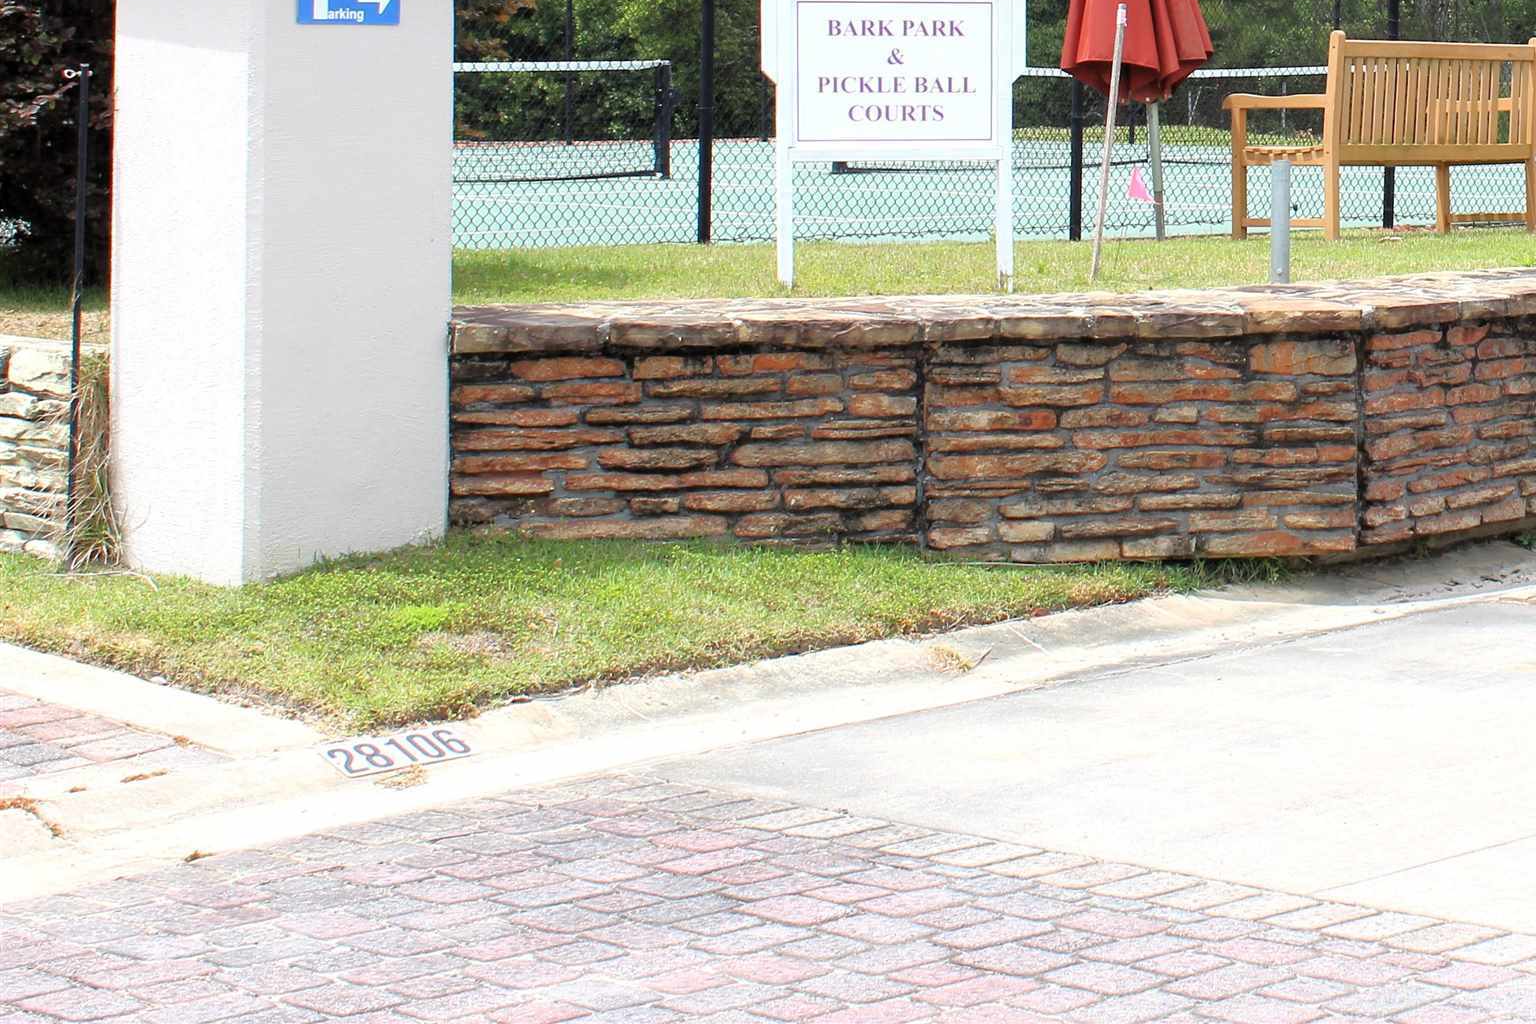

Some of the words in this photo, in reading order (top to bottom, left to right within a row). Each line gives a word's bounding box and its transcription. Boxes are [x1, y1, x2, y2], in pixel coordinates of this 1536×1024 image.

[827, 19, 894, 37] BARK
[902, 19, 966, 37] PARK
[887, 47, 904, 65] &
[818, 76, 906, 94] PICKLE
[914, 76, 977, 94] BALL
[848, 104, 945, 122] COURTS
[327, 729, 471, 774] 28106
